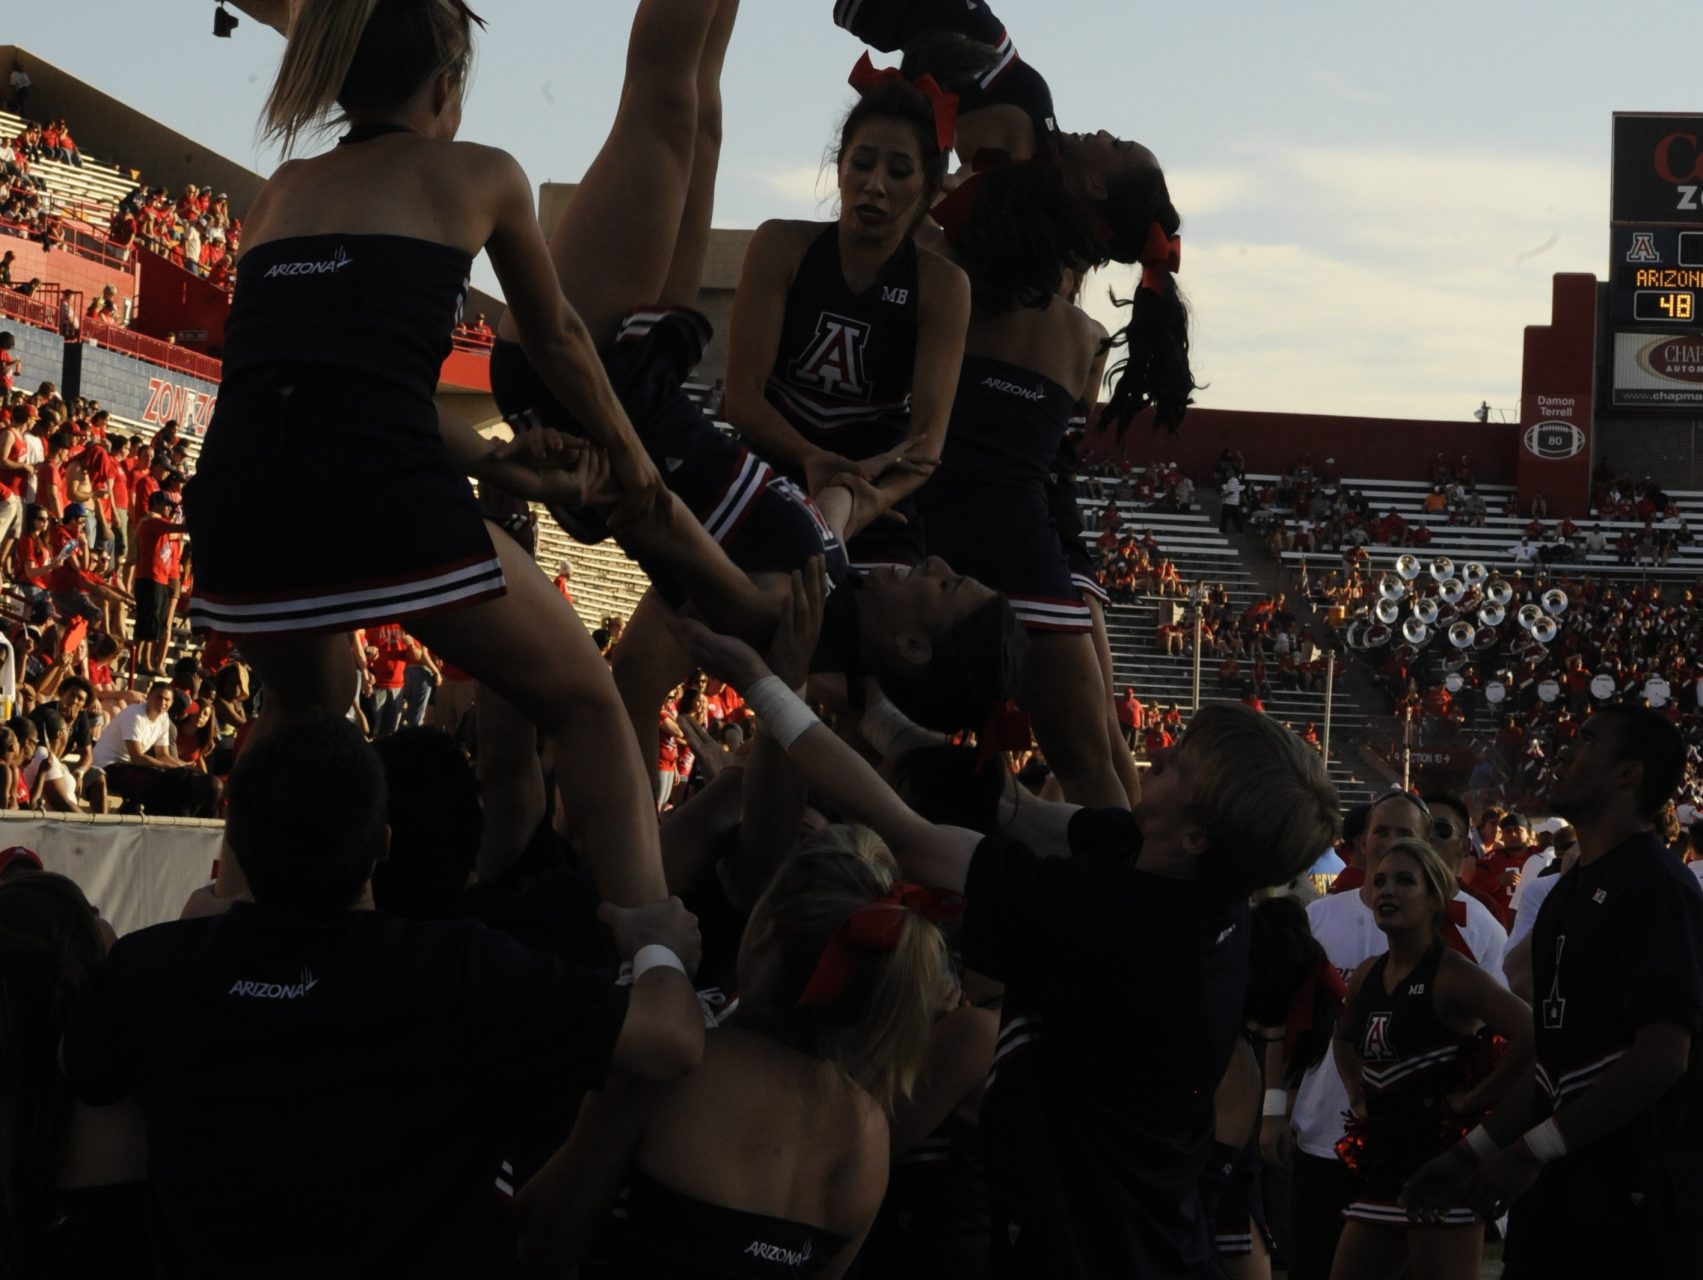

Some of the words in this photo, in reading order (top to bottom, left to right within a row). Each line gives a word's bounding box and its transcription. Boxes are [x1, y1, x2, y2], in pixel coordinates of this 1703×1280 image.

[263, 260, 337, 278] ARIZONA
[881, 285, 909, 305] MB
[1659, 293, 1691, 318] 48
[786, 311, 874, 404] A
[981, 376, 1037, 401] ARIZONA
[1537, 395, 1575, 406] Damon
[1540, 407, 1573, 417] Terrell
[1548, 435, 1563, 446] 80
[228, 980, 305, 999] ARIZONA
[1408, 983, 1425, 996] MB
[743, 1240, 802, 1266] ARIZONA
